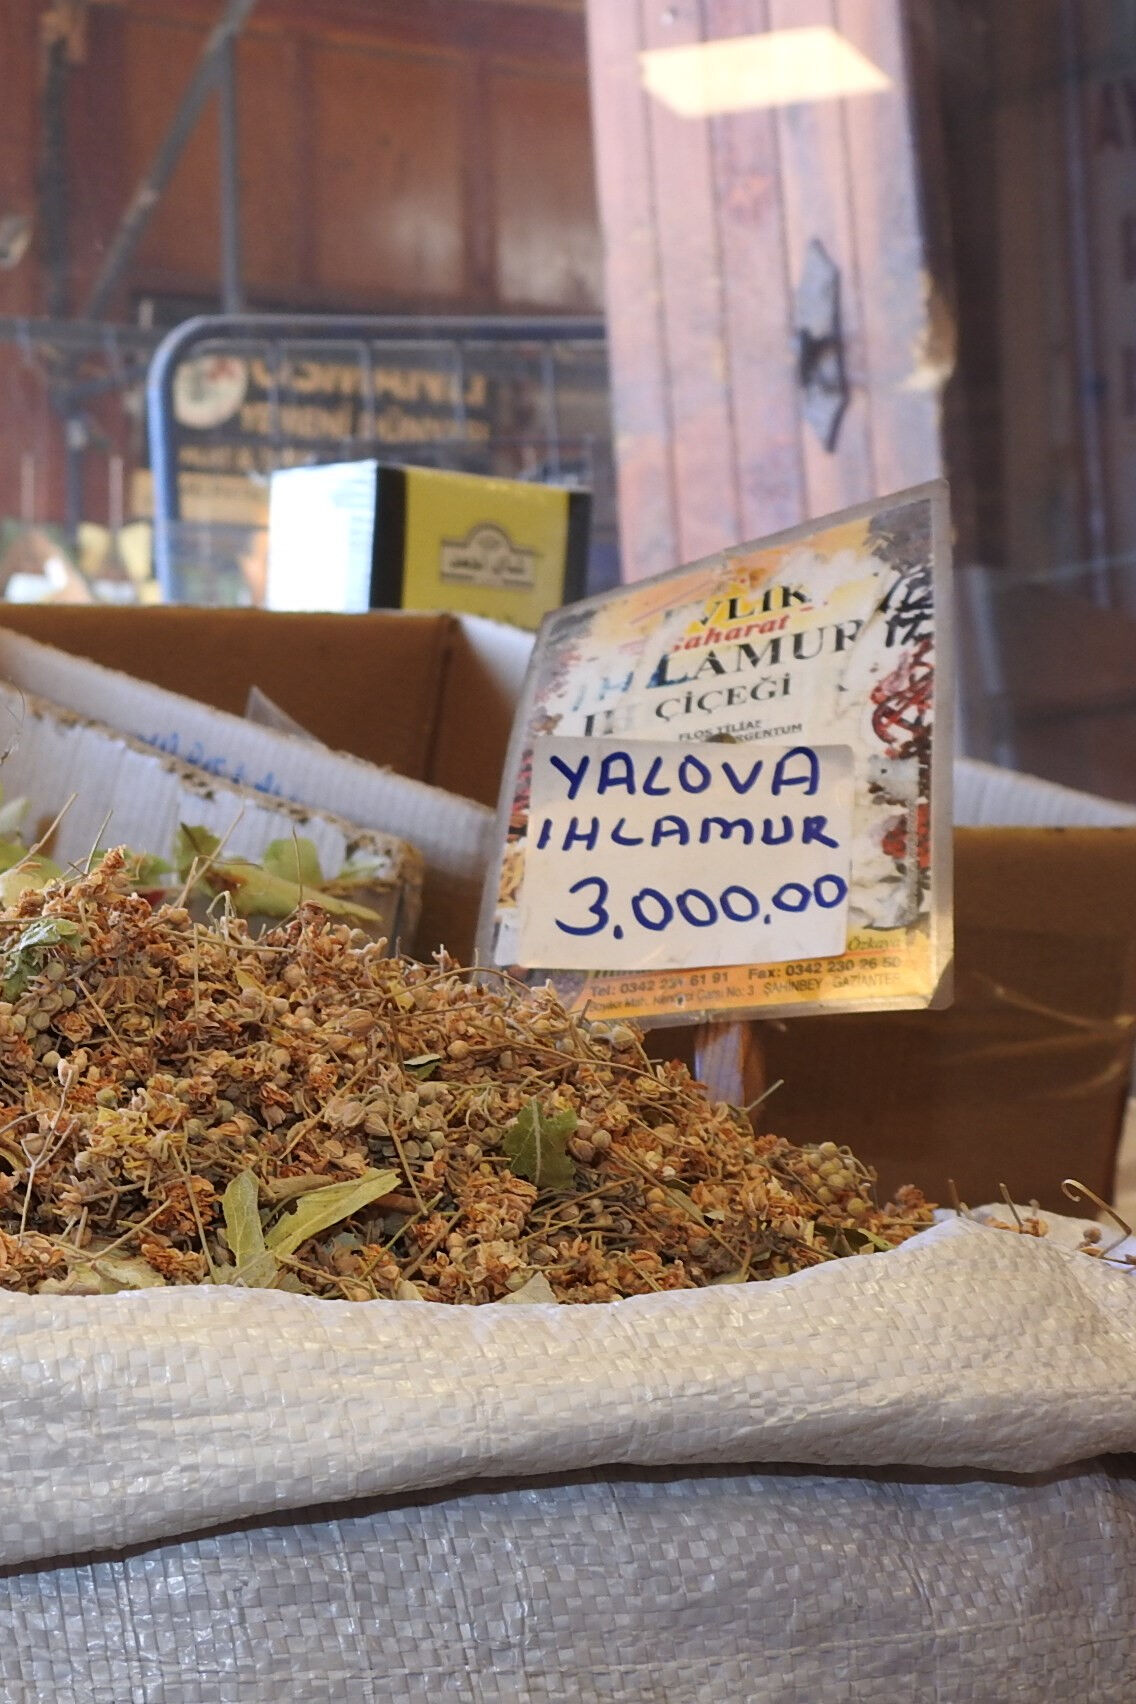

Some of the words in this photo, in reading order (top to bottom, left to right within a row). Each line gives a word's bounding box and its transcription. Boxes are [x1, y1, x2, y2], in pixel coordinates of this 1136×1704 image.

[655, 673, 791, 722] ÇİÇEĞİ
[735, 723, 804, 743] RGENTUM
[551, 747, 821, 799] YALOVA
[537, 815, 840, 851] IHLAMUR
[620, 980, 655, 994] 0342
[690, 974, 706, 987] 61
[712, 972, 728, 984] 91
[748, 967, 782, 981] Fax:
[785, 963, 822, 977] 0342
[827, 959, 854, 973] 230
